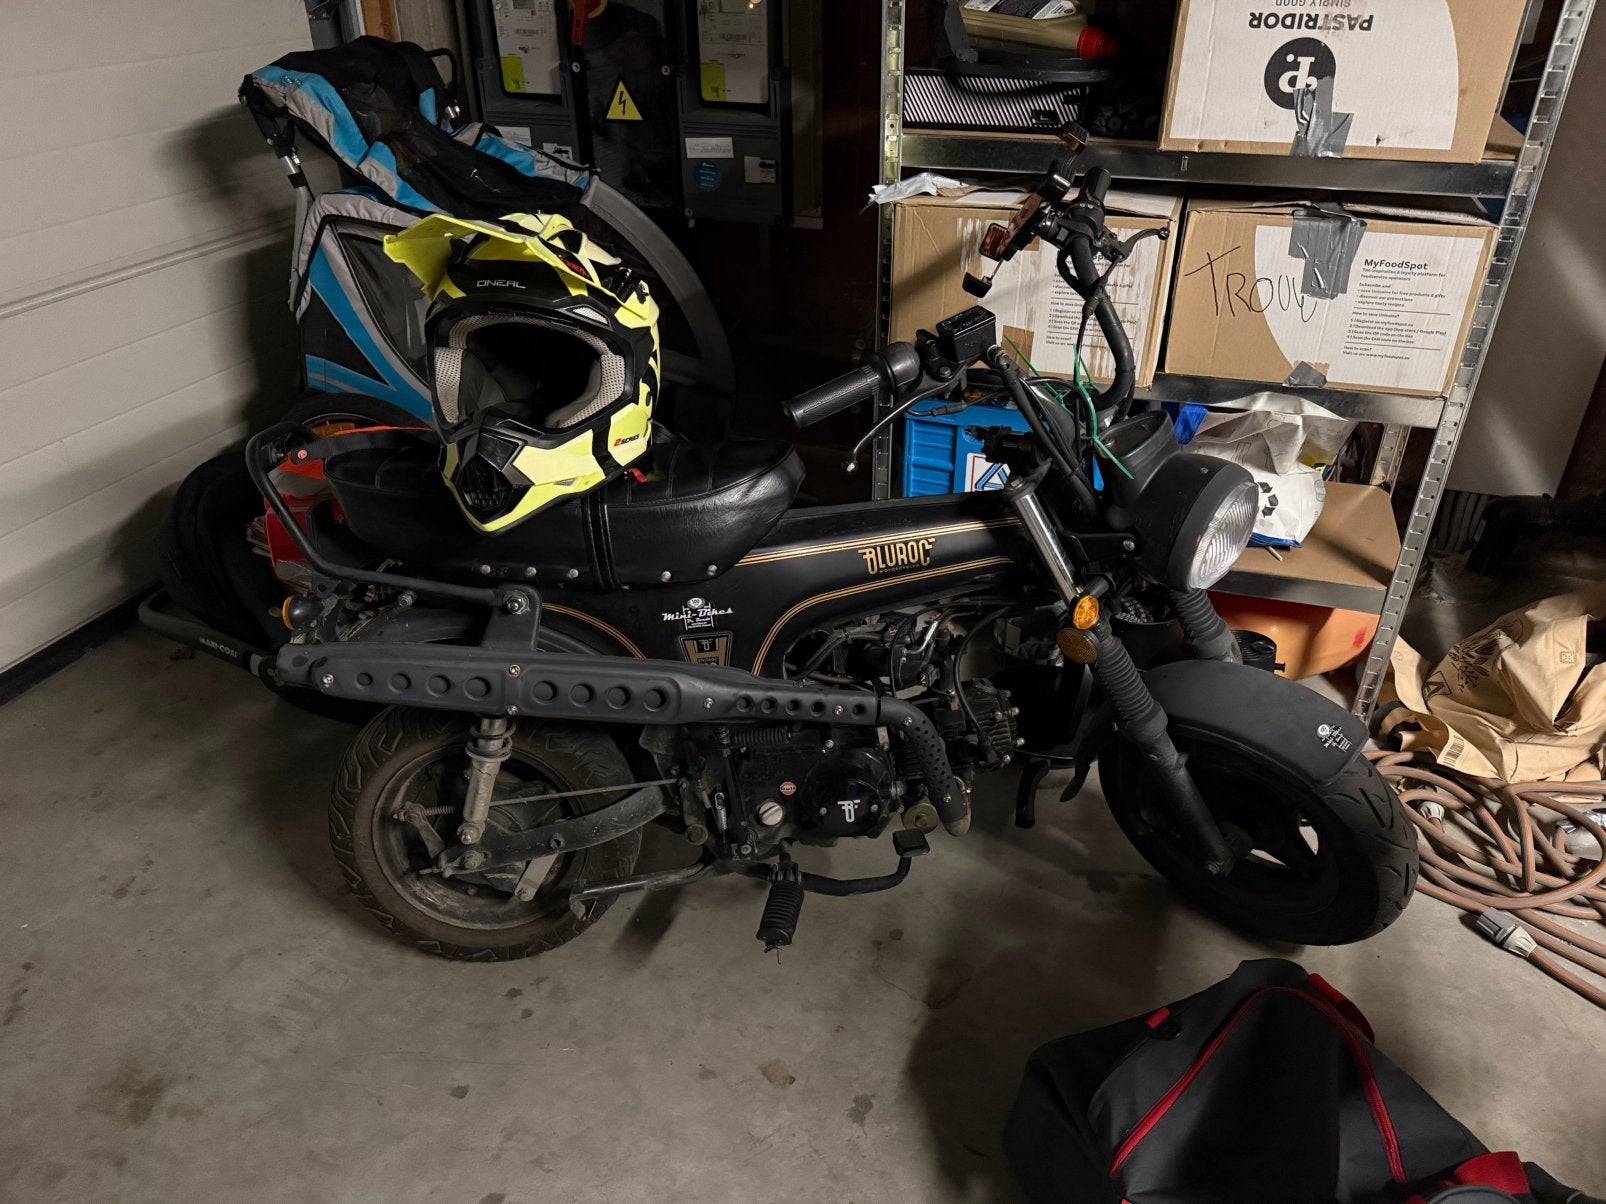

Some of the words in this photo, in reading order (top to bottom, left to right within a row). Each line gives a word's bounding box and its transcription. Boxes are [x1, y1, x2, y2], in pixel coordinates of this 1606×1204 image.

[1248, 12, 1374, 32] PASTRIDOR
[1364, 259, 1428, 270] MyFoodSpot
[476, 279, 526, 289] ONEAL
[858, 538, 936, 575] BLUROC
[662, 608, 734, 622] Mini-Bikes
